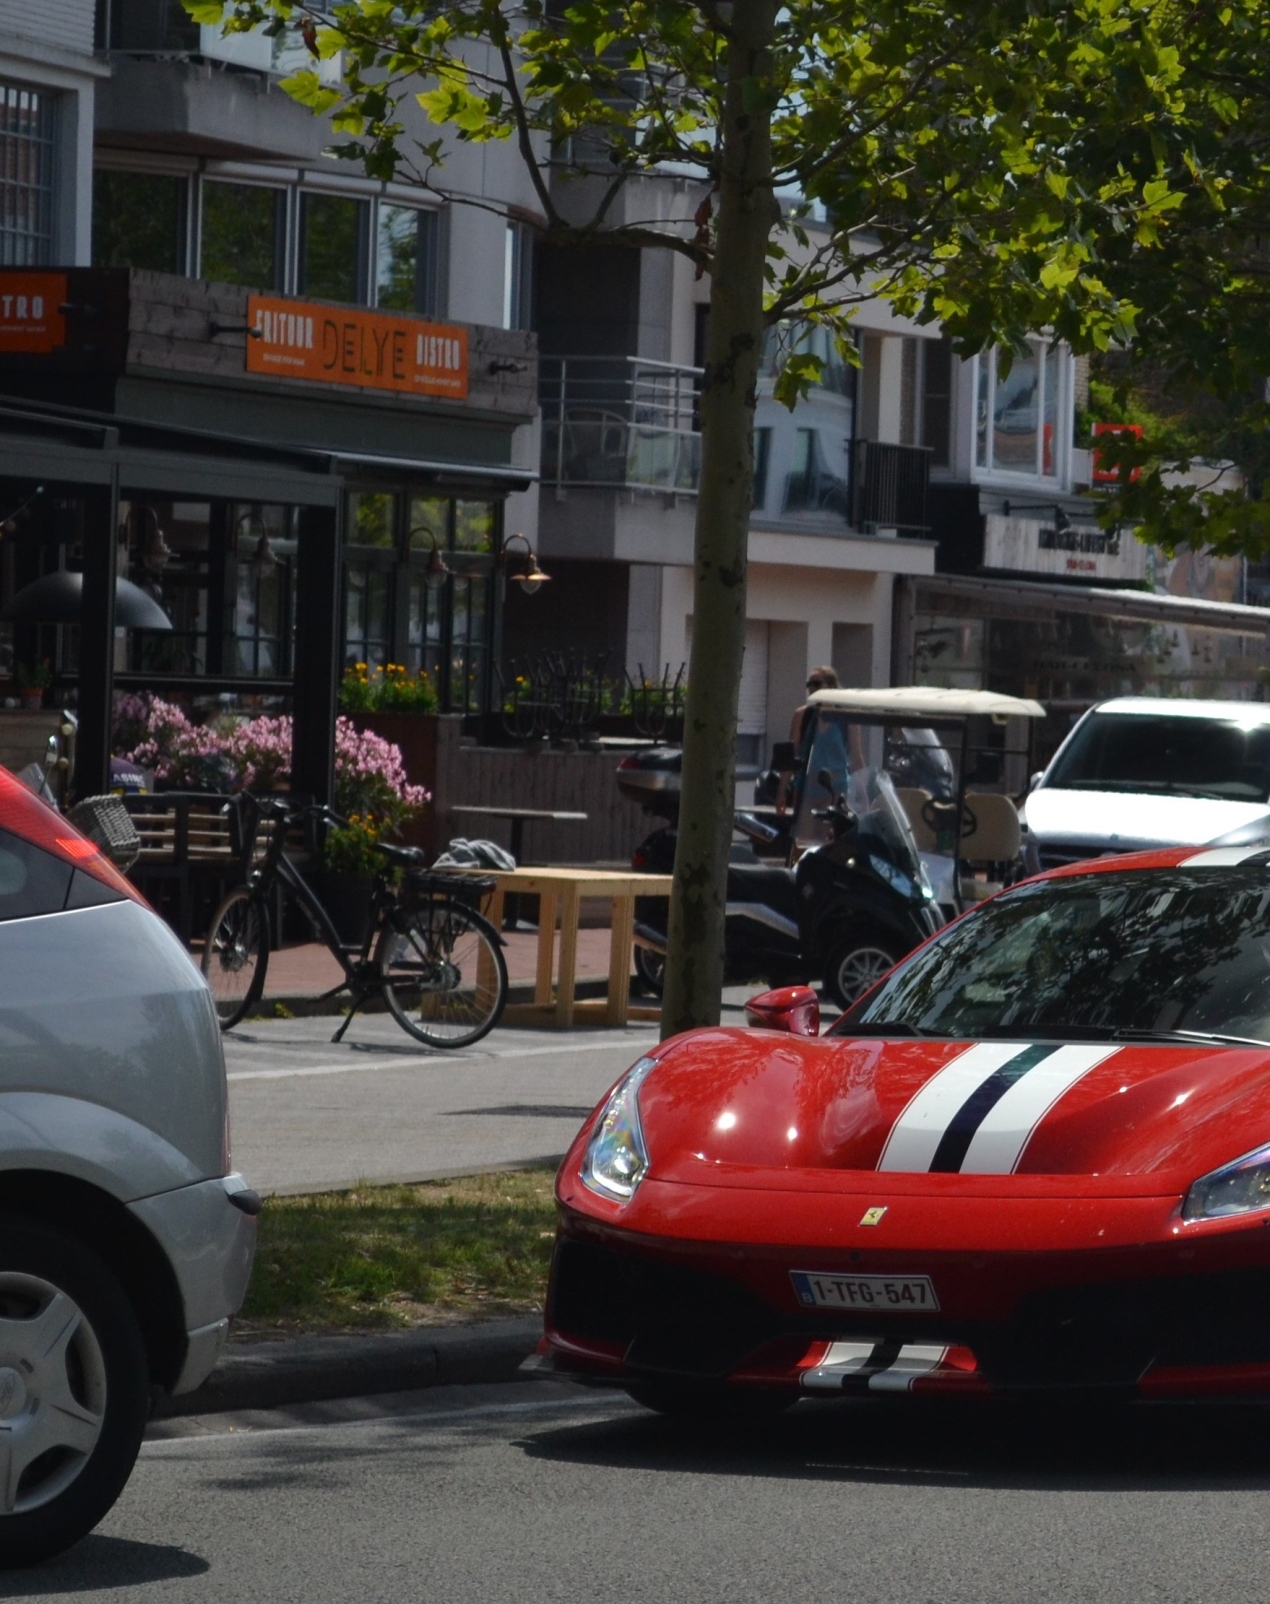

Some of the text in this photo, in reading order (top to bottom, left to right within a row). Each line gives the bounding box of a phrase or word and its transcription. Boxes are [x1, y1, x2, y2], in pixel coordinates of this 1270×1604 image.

[256, 309, 460, 379] FRITUUR DELYE BISTRO
[813, 1279, 926, 1304] 1-TFG-547
